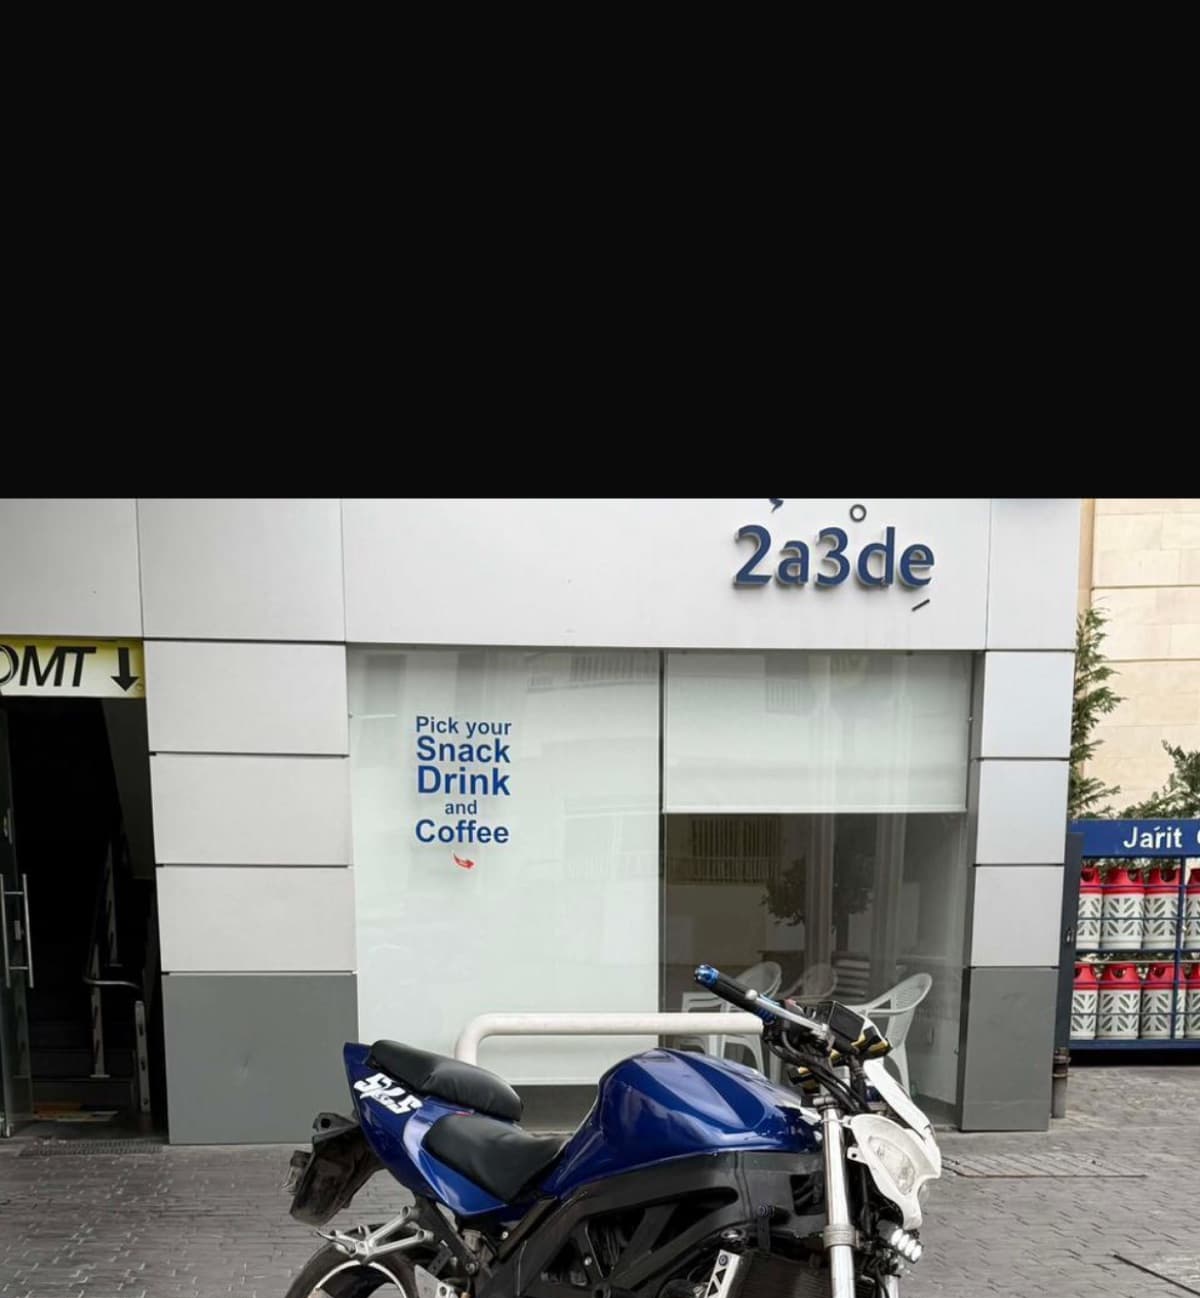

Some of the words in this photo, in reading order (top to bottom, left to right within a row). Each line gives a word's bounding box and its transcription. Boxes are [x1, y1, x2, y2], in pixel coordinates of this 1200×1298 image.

[416, 715, 459, 734] Pick
[466, 720, 512, 739] your
[416, 735, 511, 763] Snack
[417, 765, 511, 796] Drink
[444, 799, 478, 815] and
[415, 819, 510, 844] Coffee
